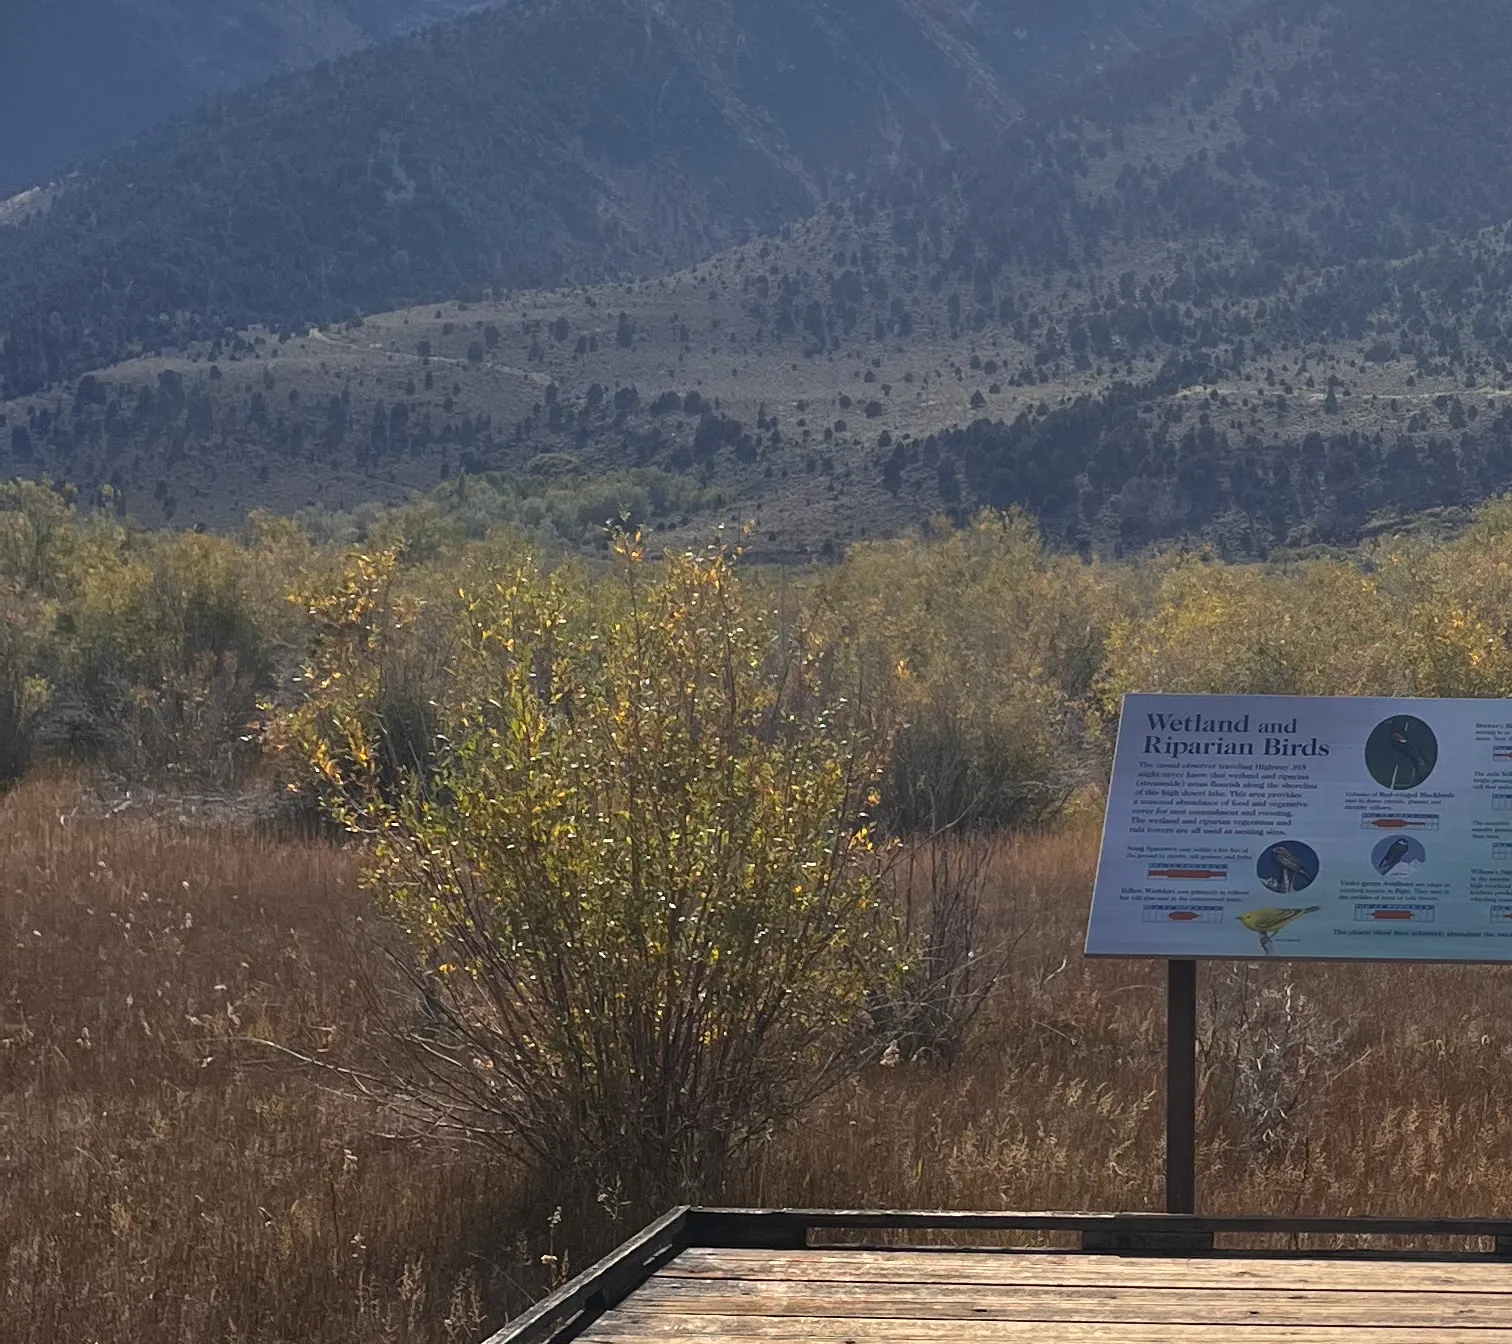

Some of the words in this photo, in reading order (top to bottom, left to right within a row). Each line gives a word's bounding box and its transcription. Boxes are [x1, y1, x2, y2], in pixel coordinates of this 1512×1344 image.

[1146, 713, 1250, 733] Wetland
[1257, 718, 1297, 734] and
[1142, 735, 1253, 758] Riparian
[1263, 737, 1330, 757] Birds
[1278, 773, 1309, 781] riparian
